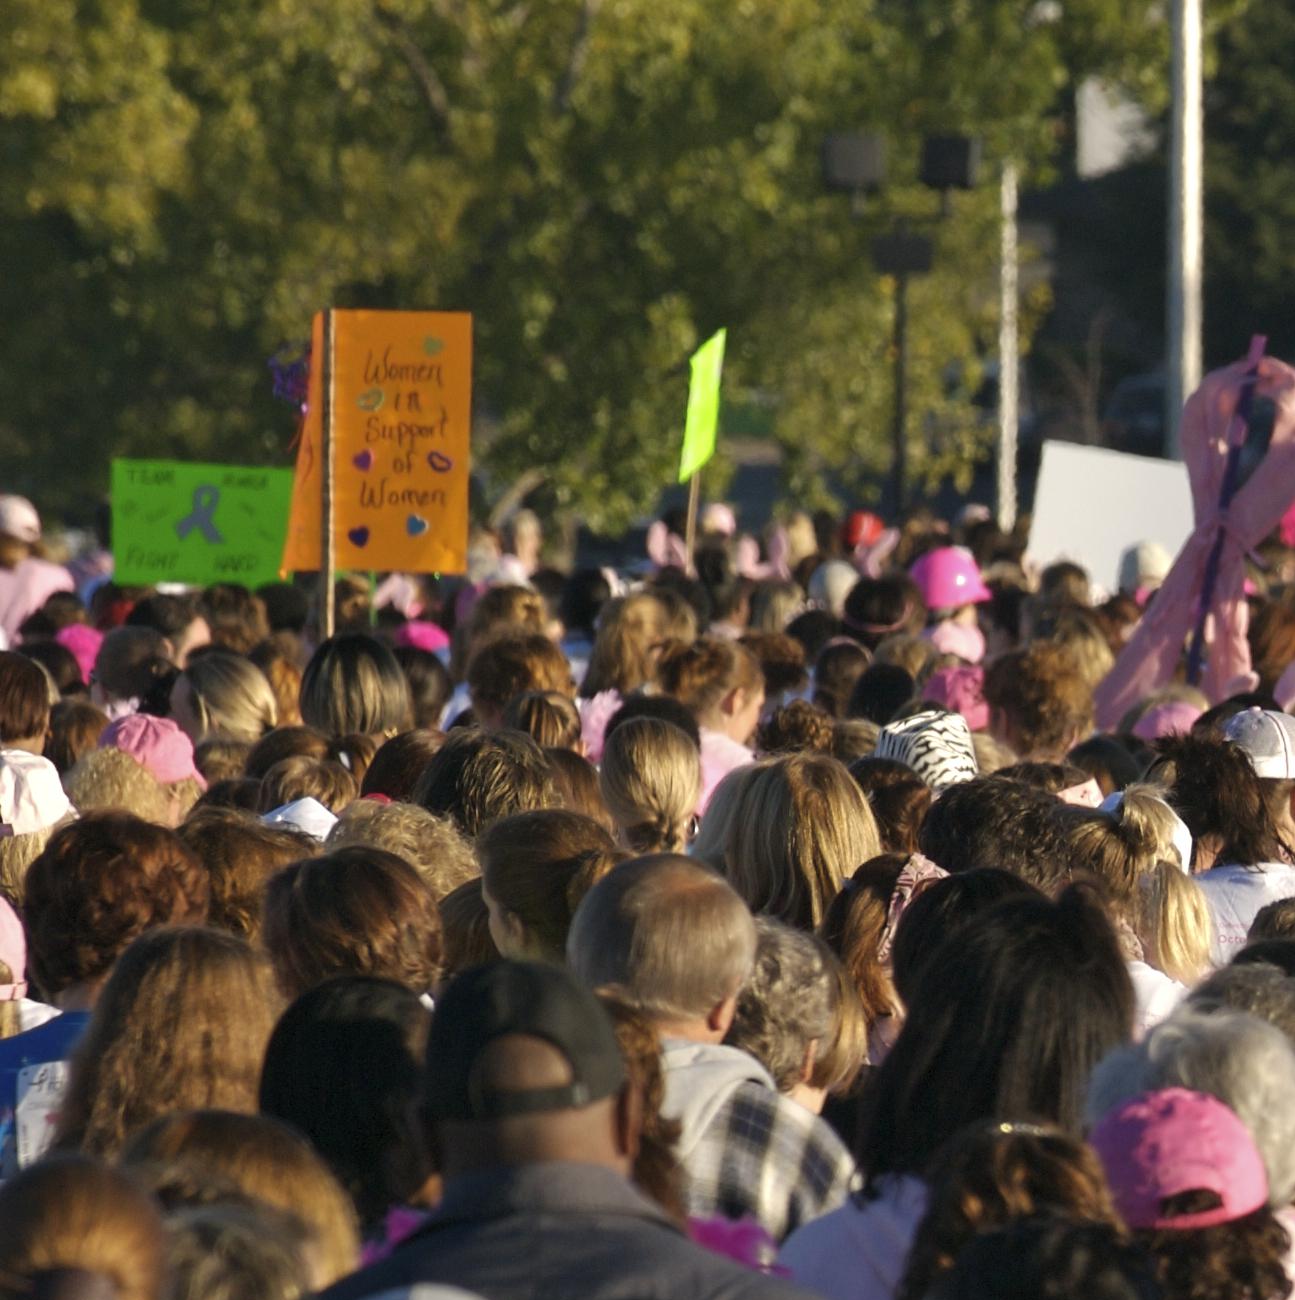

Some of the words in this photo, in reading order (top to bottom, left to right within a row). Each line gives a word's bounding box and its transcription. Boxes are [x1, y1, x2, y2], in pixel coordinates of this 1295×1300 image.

[363, 345, 444, 388] Women
[393, 390, 422, 412] in
[365, 409, 448, 446] Support
[391, 451, 415, 474] of
[358, 478, 447, 509] Women
